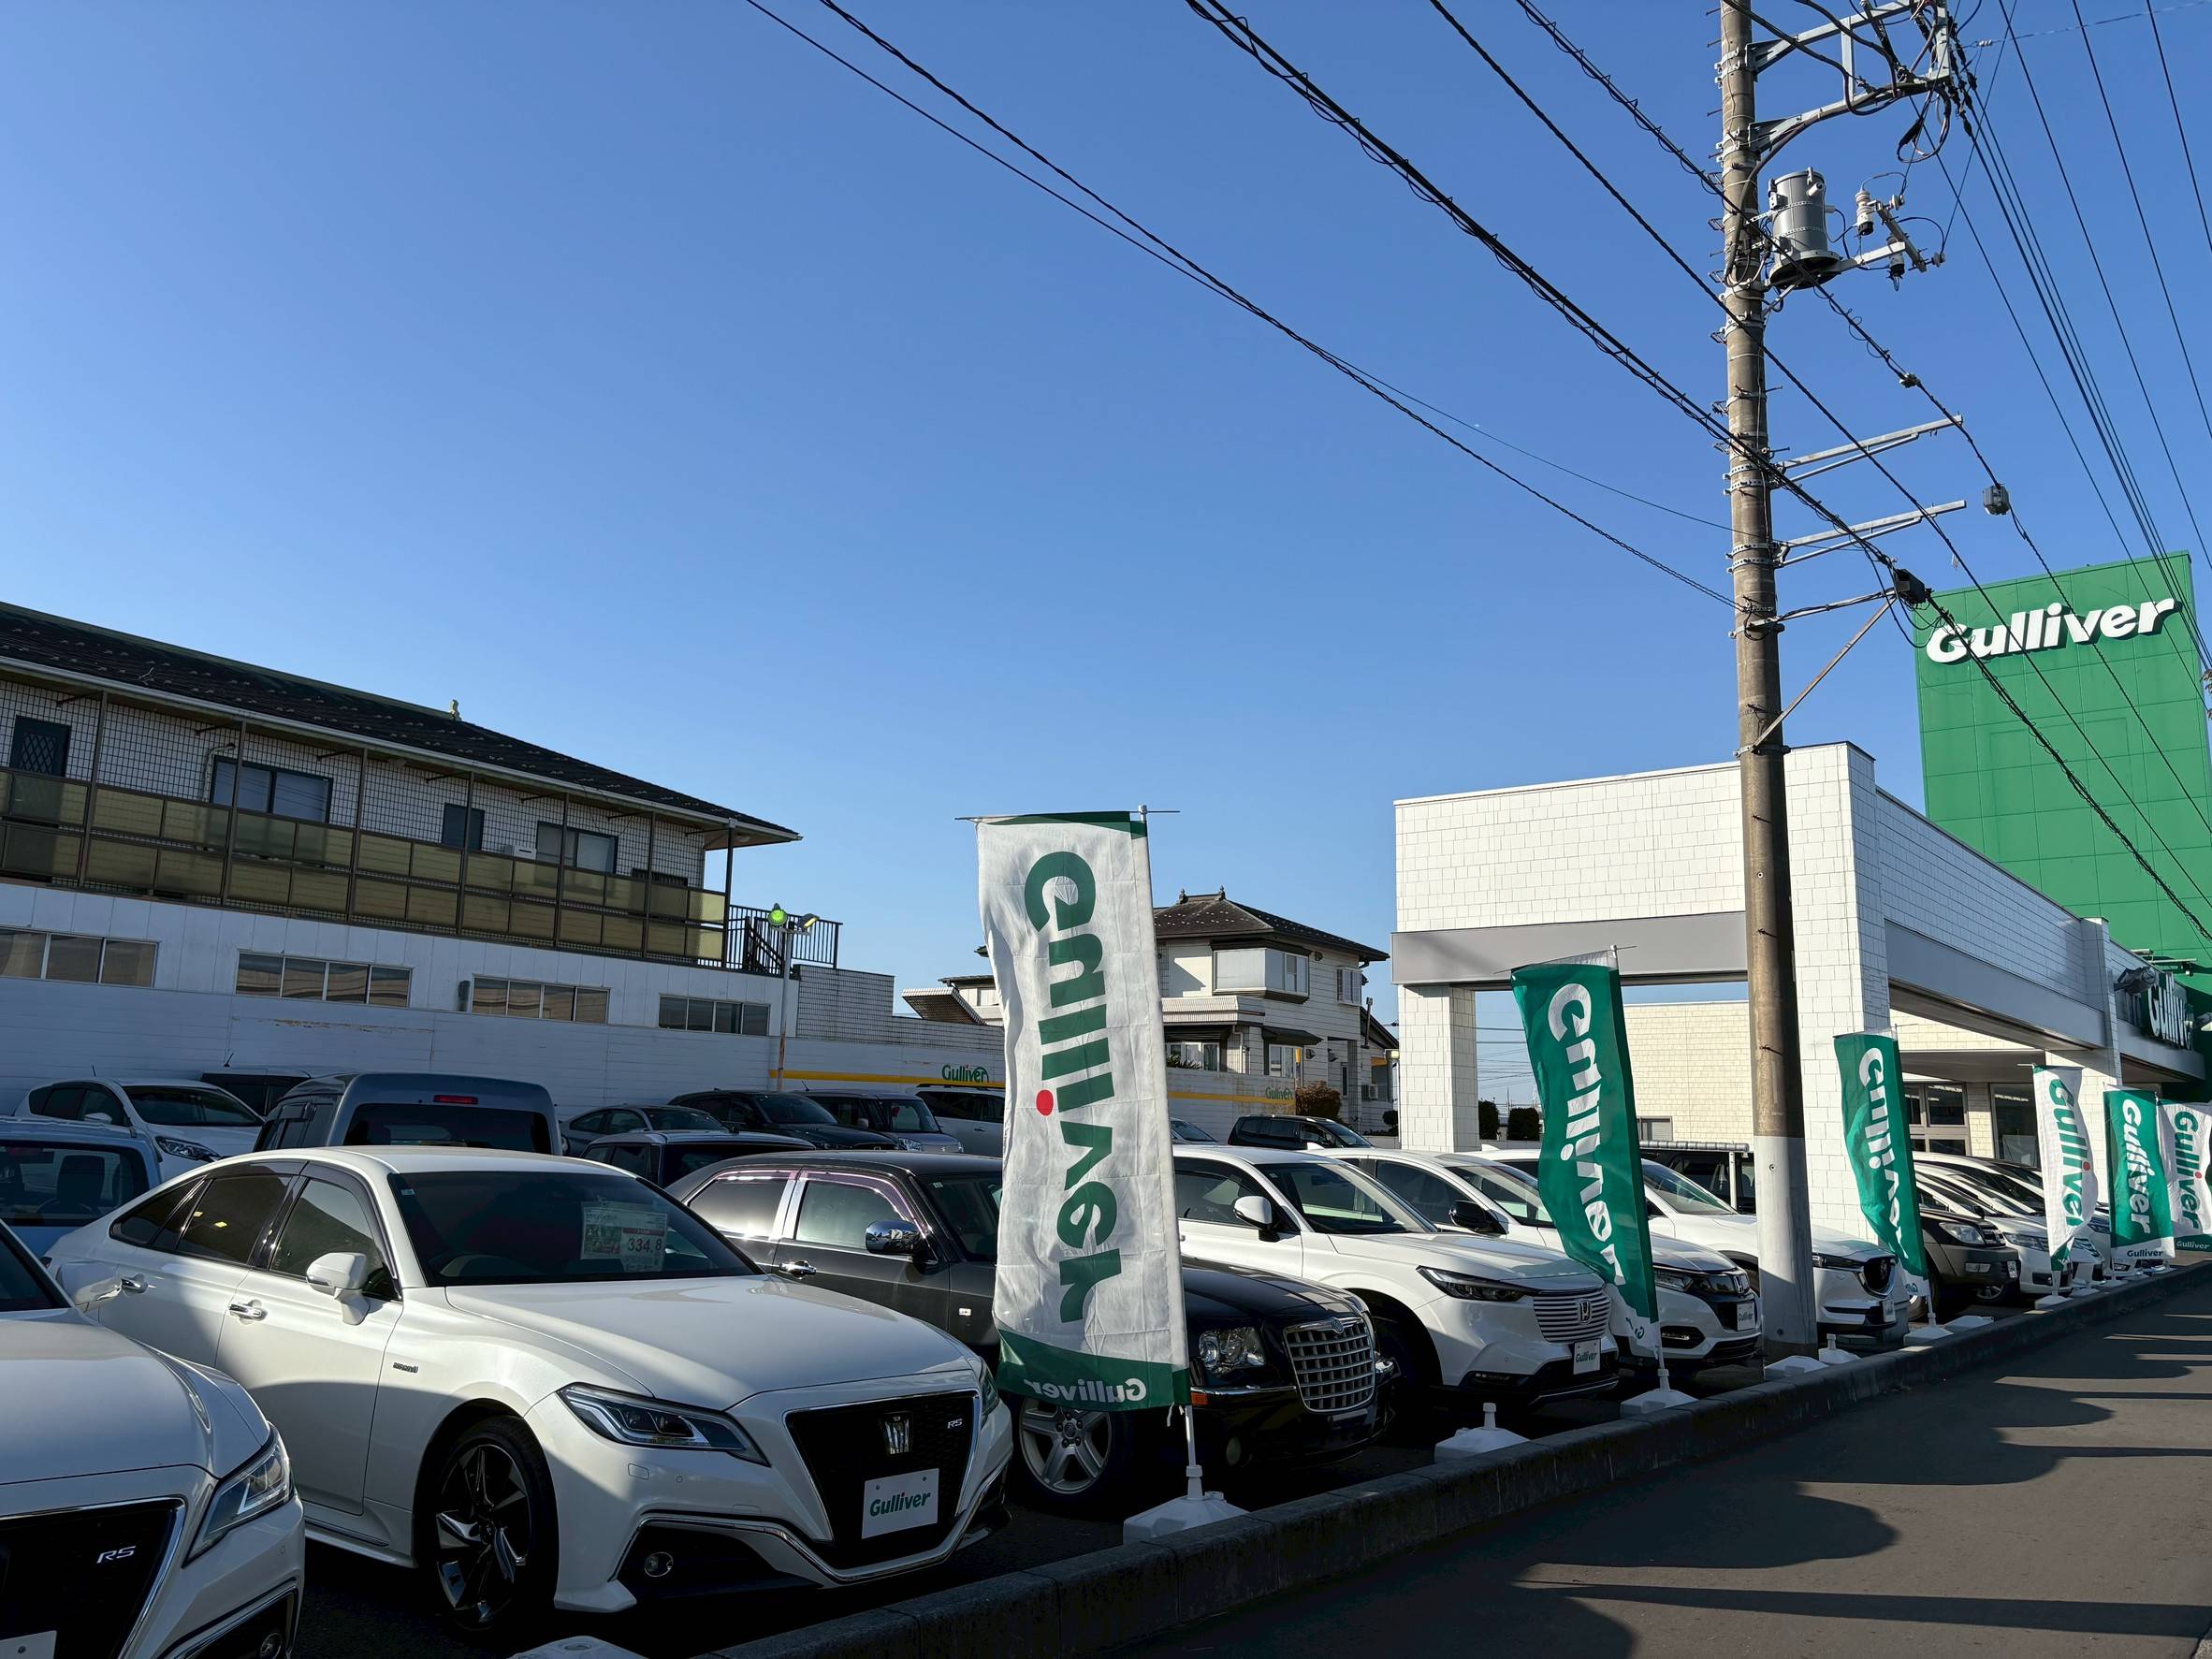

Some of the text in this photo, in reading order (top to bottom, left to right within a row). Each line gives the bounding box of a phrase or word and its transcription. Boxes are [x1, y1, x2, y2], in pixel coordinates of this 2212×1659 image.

[1926, 598, 2176, 663] Gulliver
[2147, 971, 2193, 1050] Gulliv
[941, 1064, 989, 1083] Gulliver
[2123, 1099, 2155, 1234] Gulliver
[2175, 1111, 2203, 1229] Gulliver
[628, 1237, 662, 1253] 334.8
[2127, 1248, 2163, 1258] Gulliver
[2176, 1240, 2210, 1250] Gulliver
[947, 1419, 963, 1429] RS
[869, 1492, 931, 1517] Gulliver
[96, 1545, 137, 1564] RS
